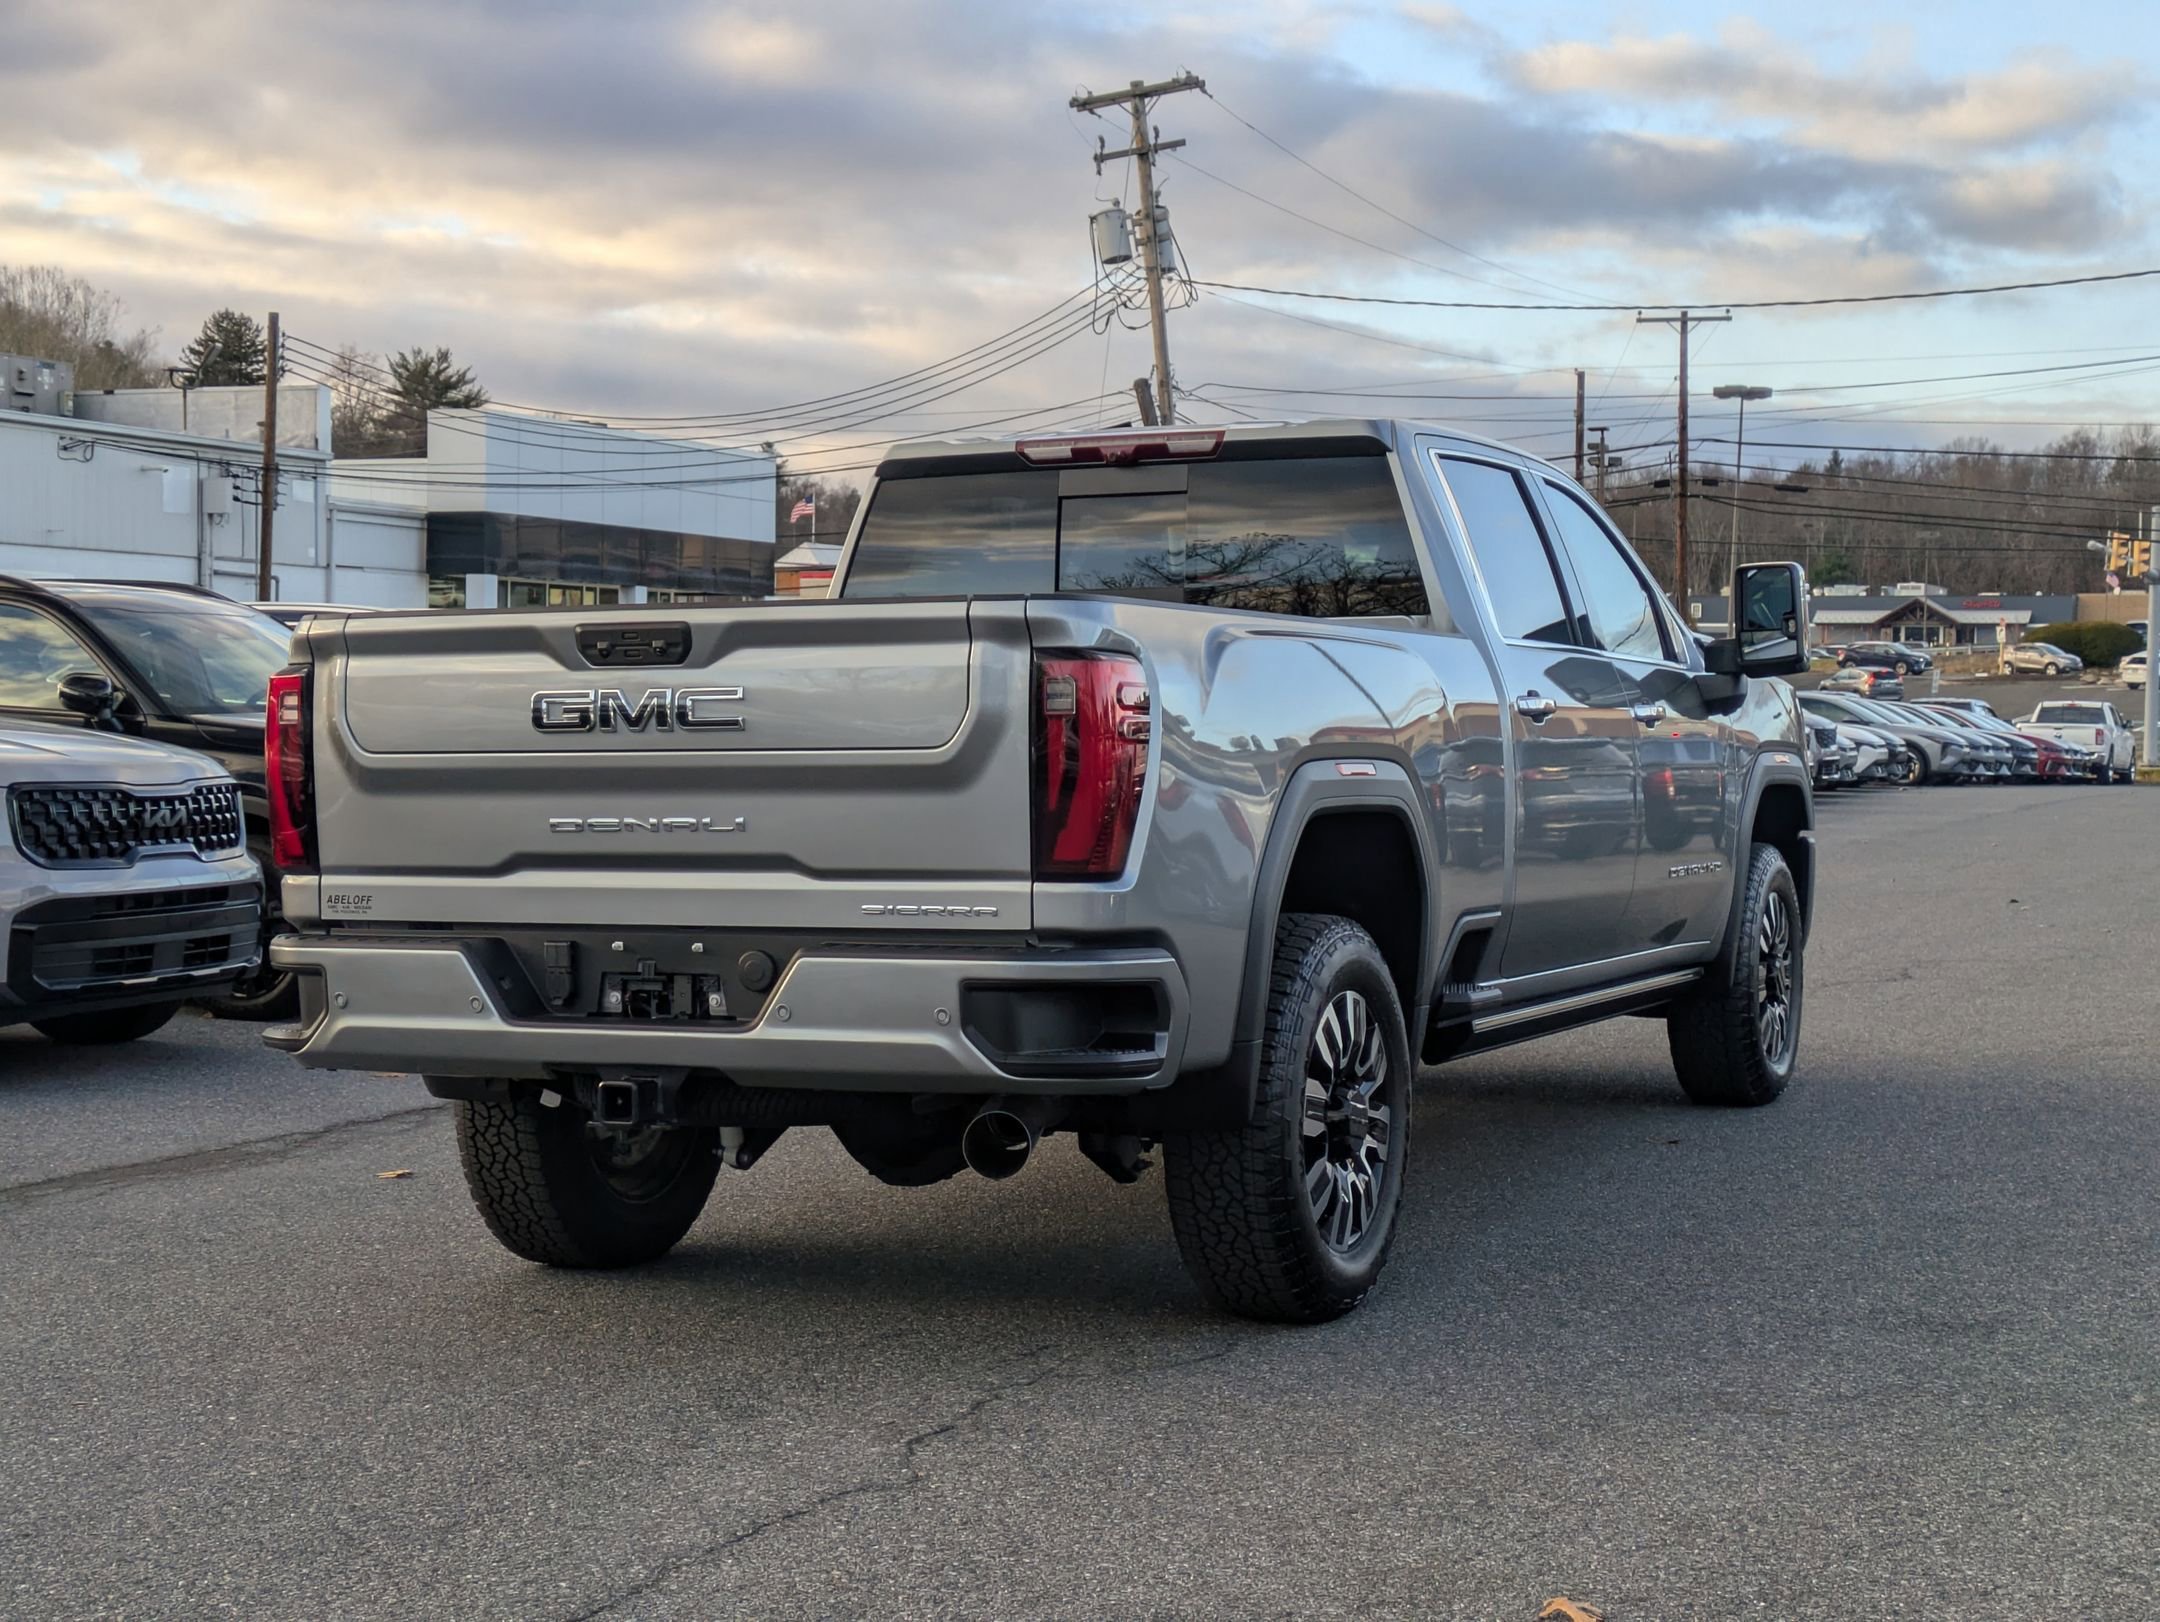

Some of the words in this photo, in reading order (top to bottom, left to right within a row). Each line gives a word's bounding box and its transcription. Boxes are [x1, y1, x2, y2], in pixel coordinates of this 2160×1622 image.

[531, 686, 745, 734] GMC
[144, 808, 187, 828] KIA
[549, 817, 746, 833] DENALI
[326, 894, 373, 905] ABELOFF
[861, 904, 998, 917] SIERRA
